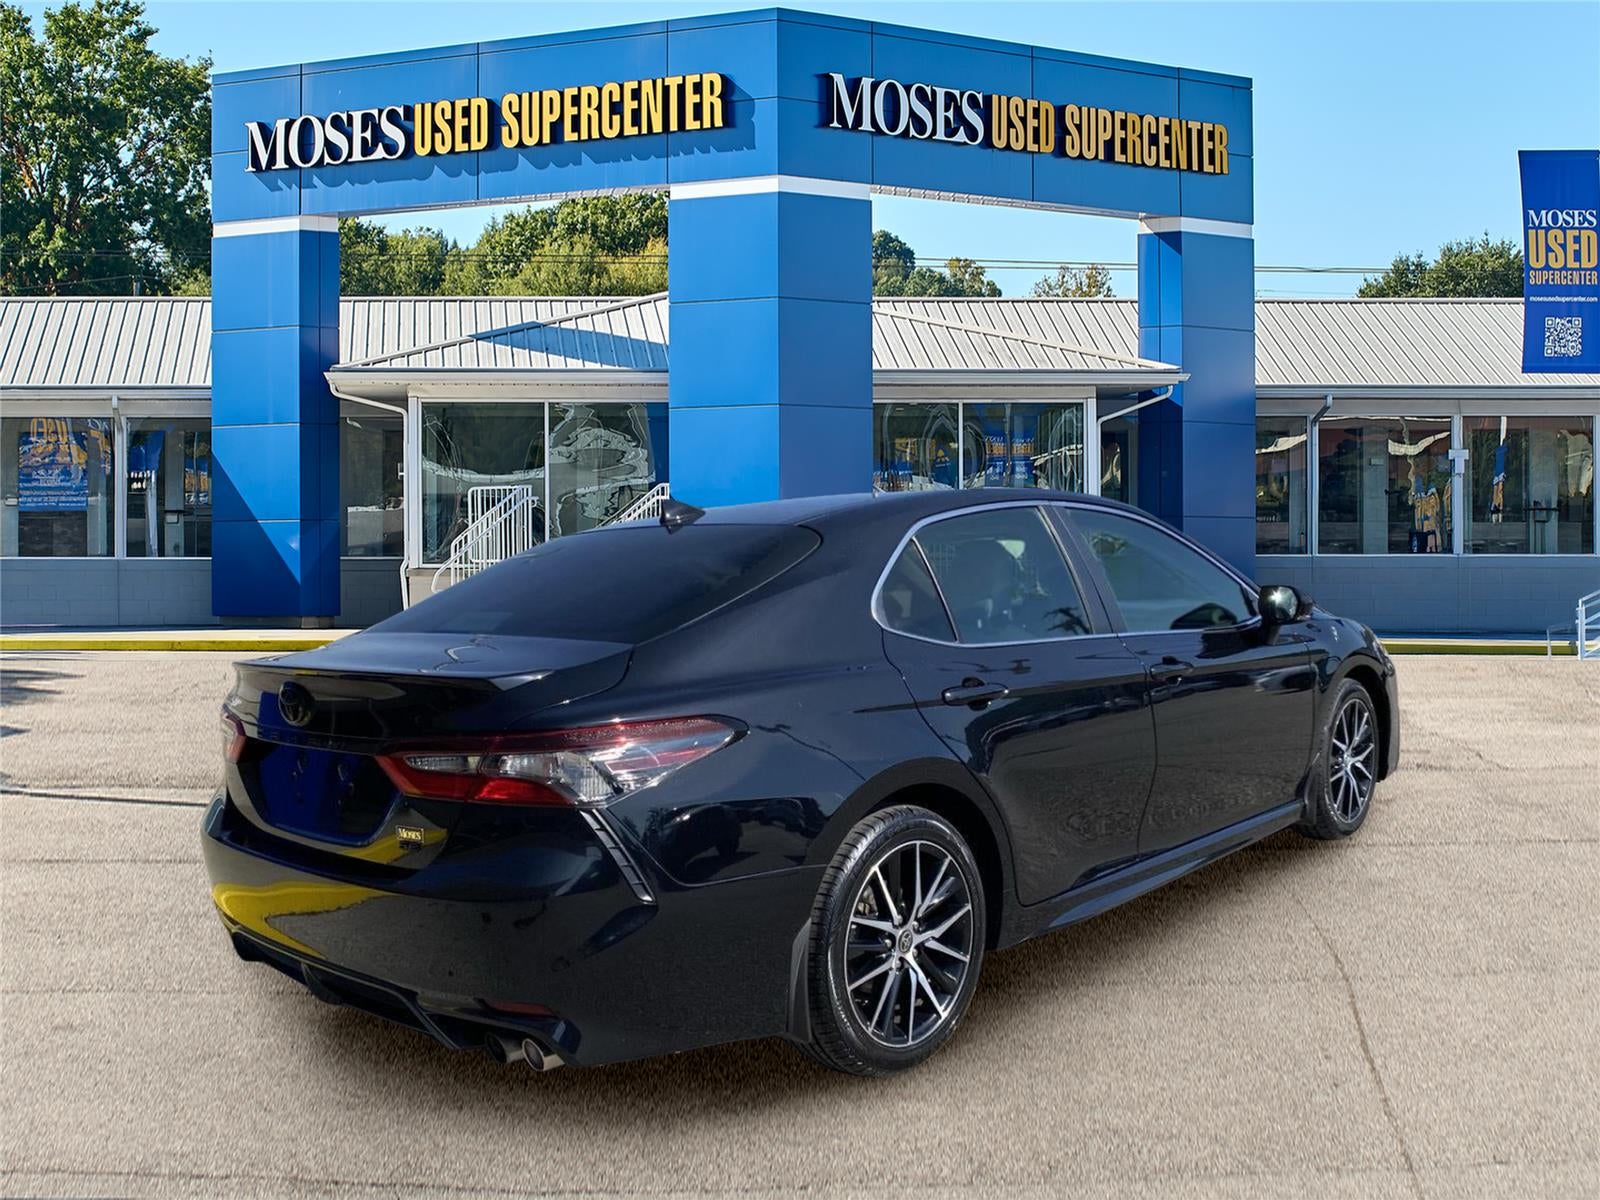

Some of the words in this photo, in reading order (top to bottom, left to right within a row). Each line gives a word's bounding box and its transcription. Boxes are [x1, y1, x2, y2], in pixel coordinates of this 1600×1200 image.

[245, 104, 406, 173] MOSES
[413, 97, 488, 156] USED
[501, 72, 725, 149] SUPERCENTER
[828, 72, 985, 145] MOSES
[991, 94, 1055, 153] USED
[1065, 104, 1229, 175] SUPERCENTER
[1527, 209, 1597, 228] MOSES
[1528, 229, 1598, 269] USED
[1529, 270, 1598, 285] SUPERCENTER
